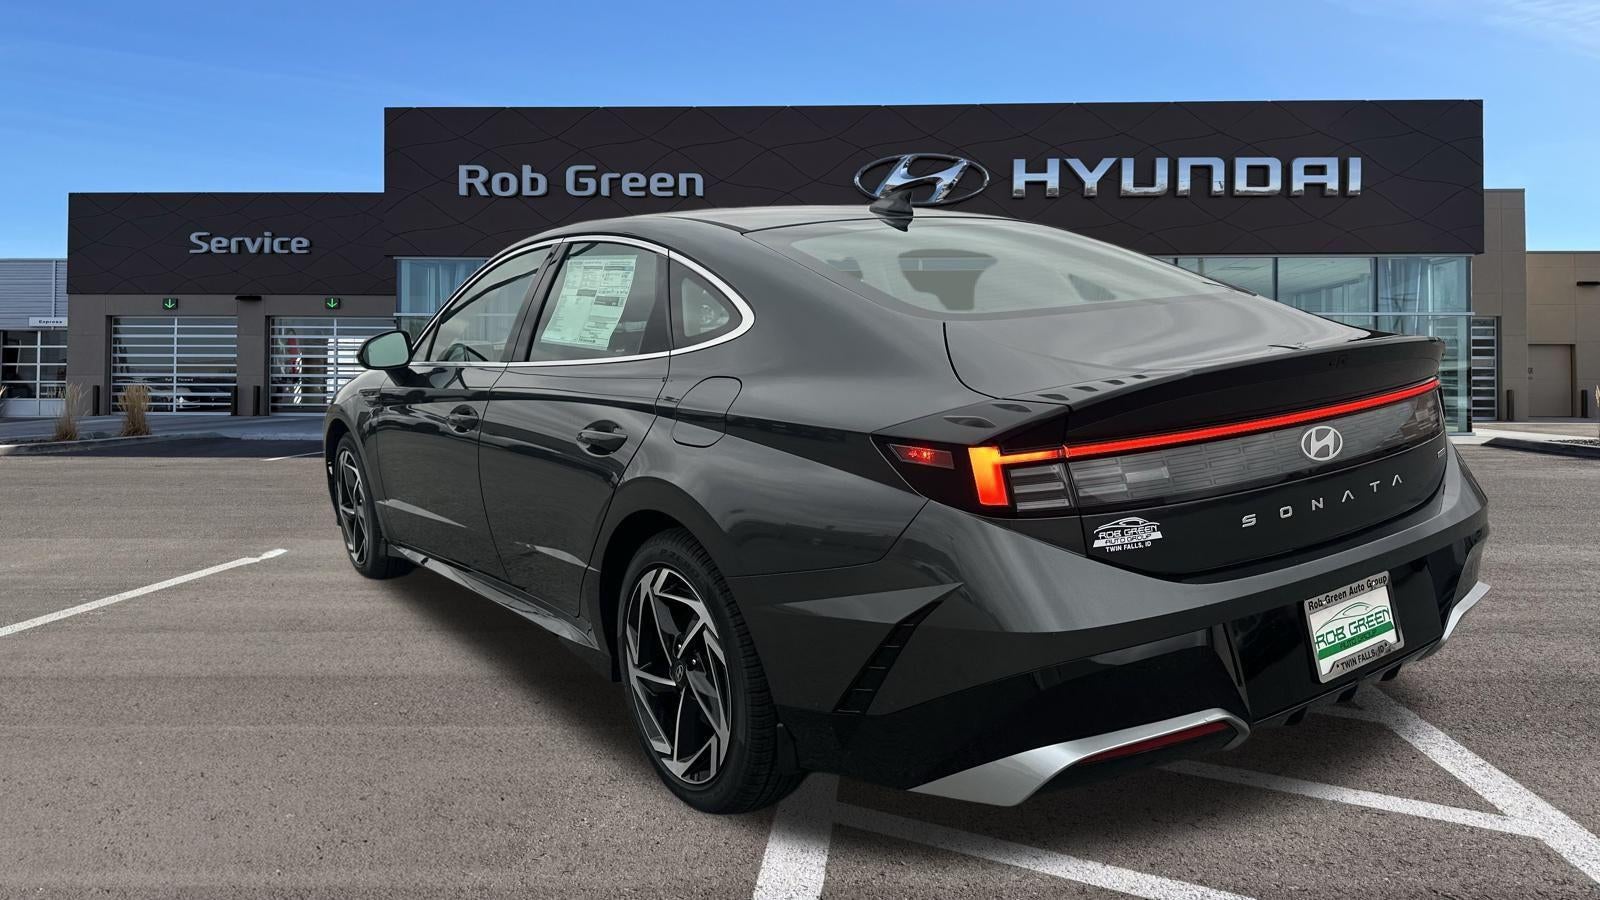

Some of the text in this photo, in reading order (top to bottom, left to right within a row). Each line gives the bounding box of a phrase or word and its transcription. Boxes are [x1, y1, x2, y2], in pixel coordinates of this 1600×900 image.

[457, 164, 705, 197] Rob Green
[1011, 156, 1362, 199] HYUNDAI
[188, 231, 311, 255] Service
[1241, 473, 1403, 528] SONATA
[1098, 525, 1158, 539] ROB GREEN
[1105, 537, 1126, 545] AUTO
[1123, 542, 1144, 550] FALLS,
[1308, 575, 1388, 611] Rob Green Auto Group
[1315, 626, 1346, 649] ROB
[1348, 608, 1390, 636] GREEN
[1340, 656, 1358, 671] TWIN
[1378, 645, 1385, 654] ID
